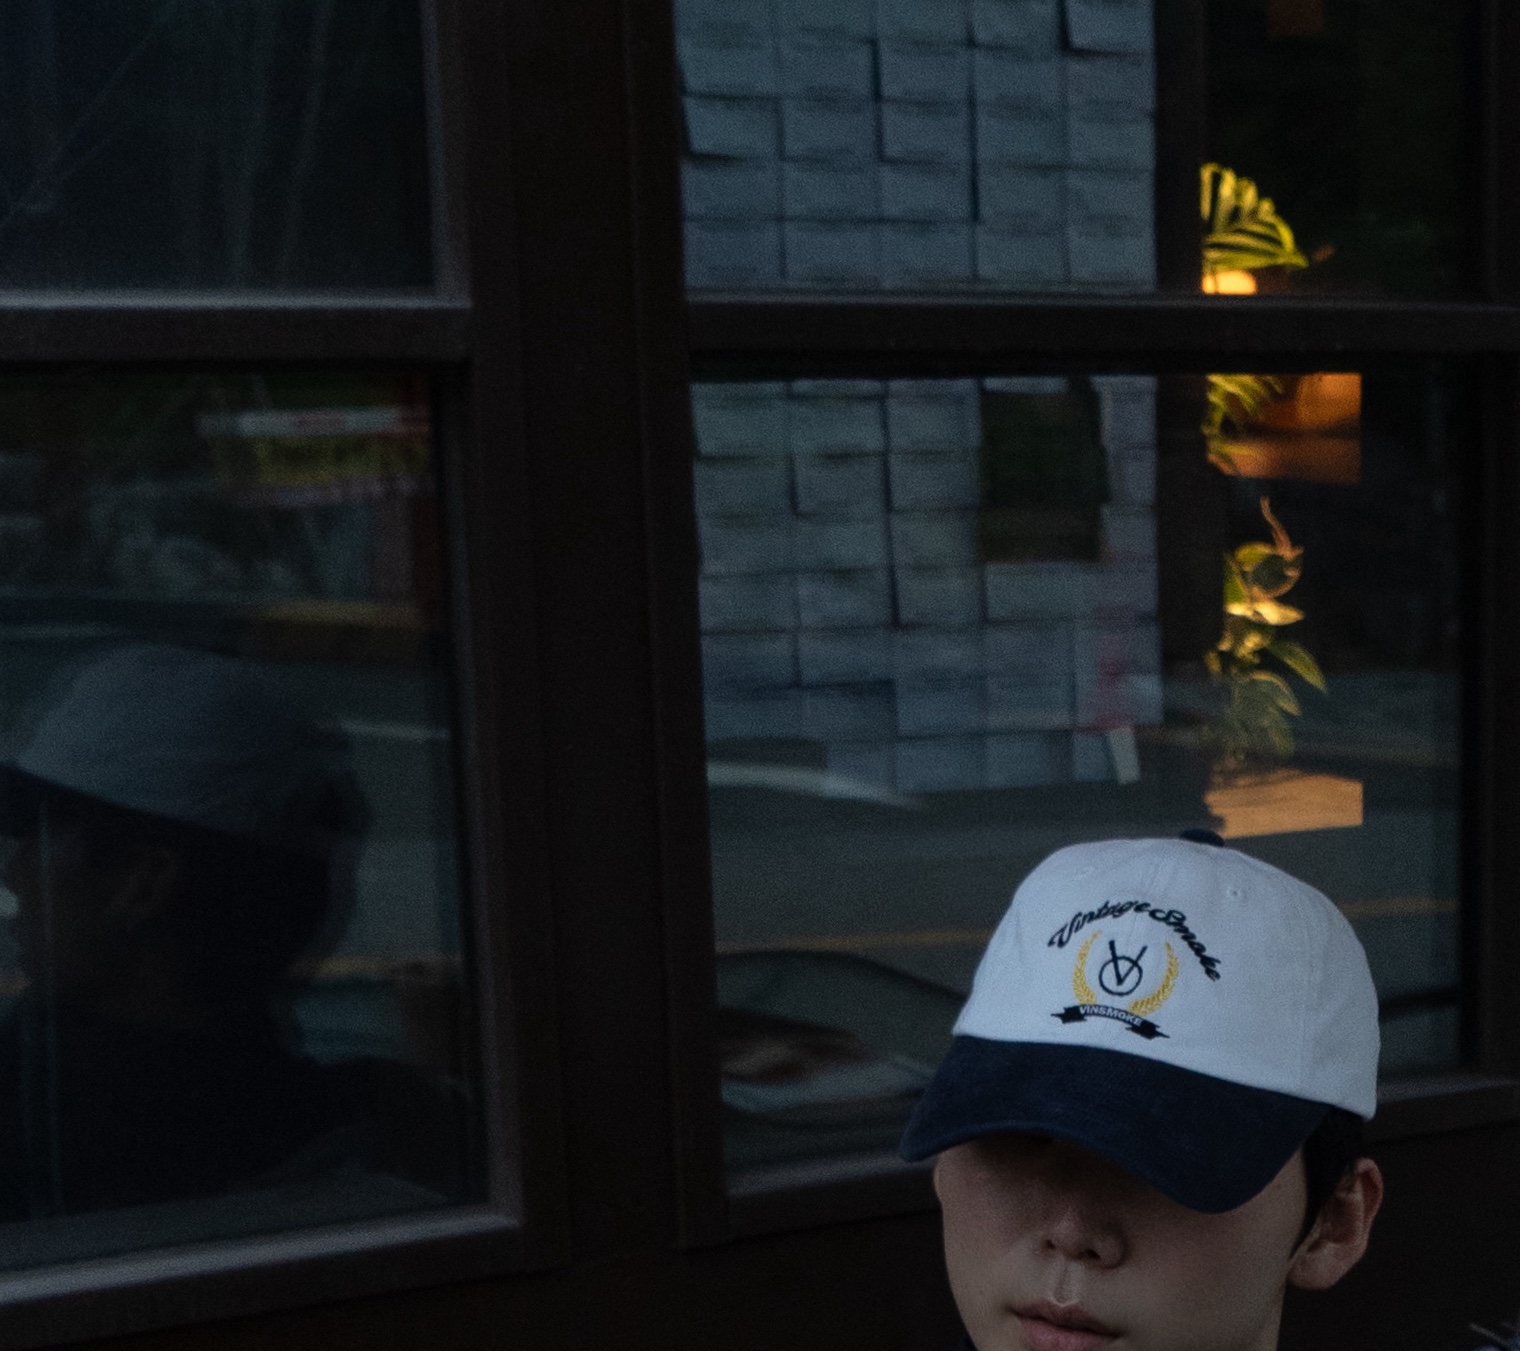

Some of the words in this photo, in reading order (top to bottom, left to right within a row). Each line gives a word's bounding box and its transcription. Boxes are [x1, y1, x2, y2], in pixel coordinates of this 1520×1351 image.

[1047, 900, 1151, 948] Vintage
[1149, 908, 1222, 982] Smoke
[1080, 1005, 1142, 1026] VINSMOKE
